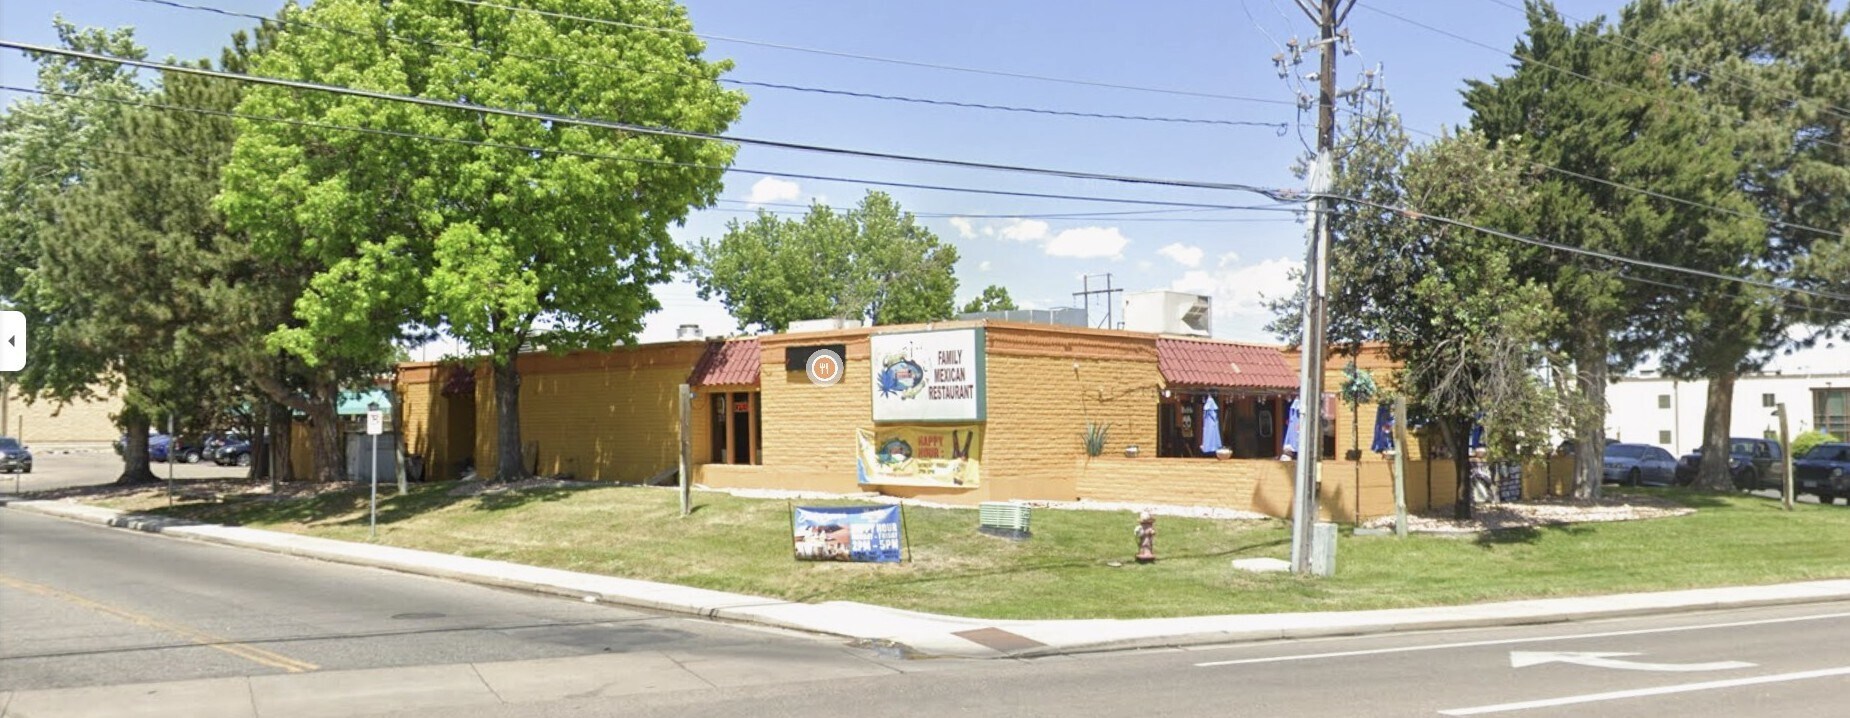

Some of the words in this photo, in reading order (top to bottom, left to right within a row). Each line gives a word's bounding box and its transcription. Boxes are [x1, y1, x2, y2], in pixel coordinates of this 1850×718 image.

[938, 350, 962, 365] FAMILY
[934, 368, 966, 382] MEXICAN
[928, 385, 973, 400] RESTAURANT
[918, 435, 944, 447] HAPPY
[876, 522, 898, 532] HOUR
[852, 540, 871, 551] 2PM
[879, 539, 899, 551] 5PM
